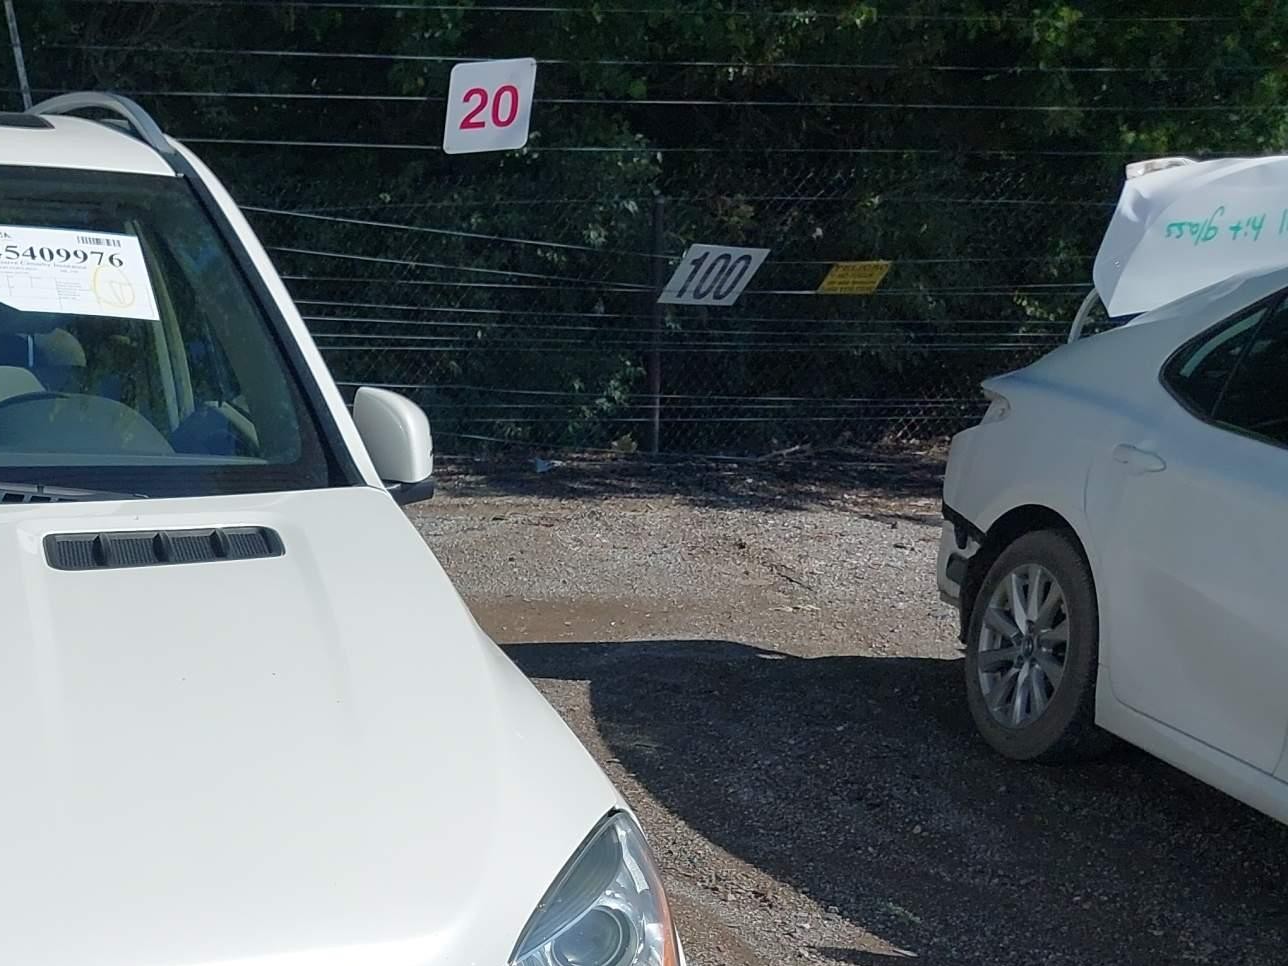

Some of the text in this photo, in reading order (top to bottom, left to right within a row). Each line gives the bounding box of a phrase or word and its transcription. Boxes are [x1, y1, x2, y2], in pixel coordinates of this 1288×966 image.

[459, 84, 520, 130] 20
[1165, 206, 1225, 246] glass
[675, 251, 752, 300] 100
